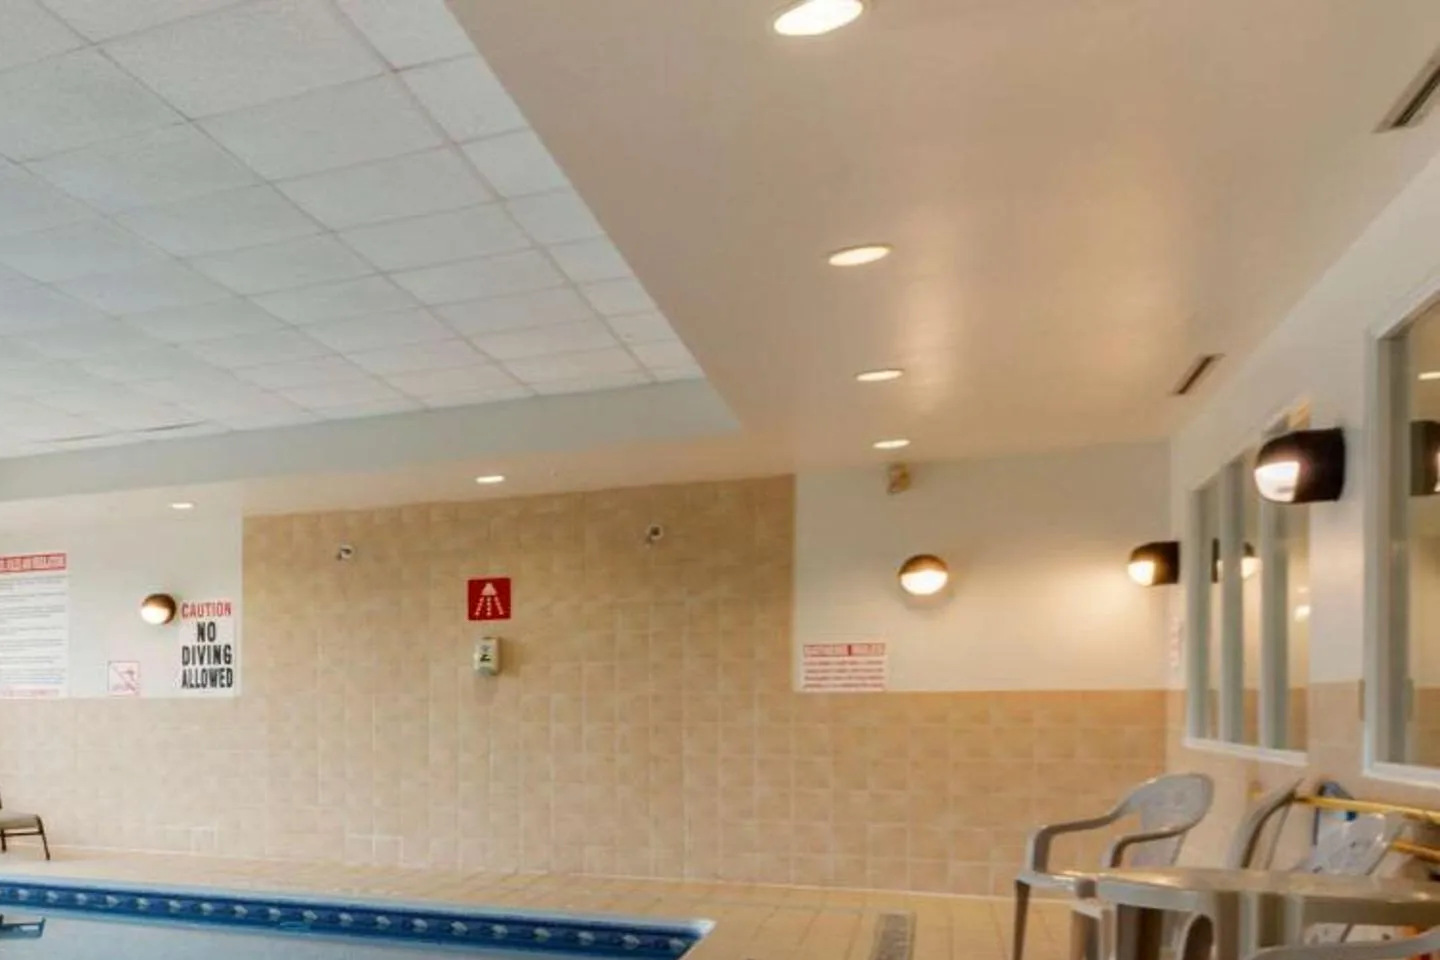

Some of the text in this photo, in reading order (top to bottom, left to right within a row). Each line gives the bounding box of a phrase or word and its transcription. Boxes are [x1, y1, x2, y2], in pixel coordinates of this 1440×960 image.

[181, 602, 232, 618] CAUTION
[197, 621, 216, 642] NO
[182, 645, 232, 666] DIVING
[182, 668, 233, 689] ALLOWED
